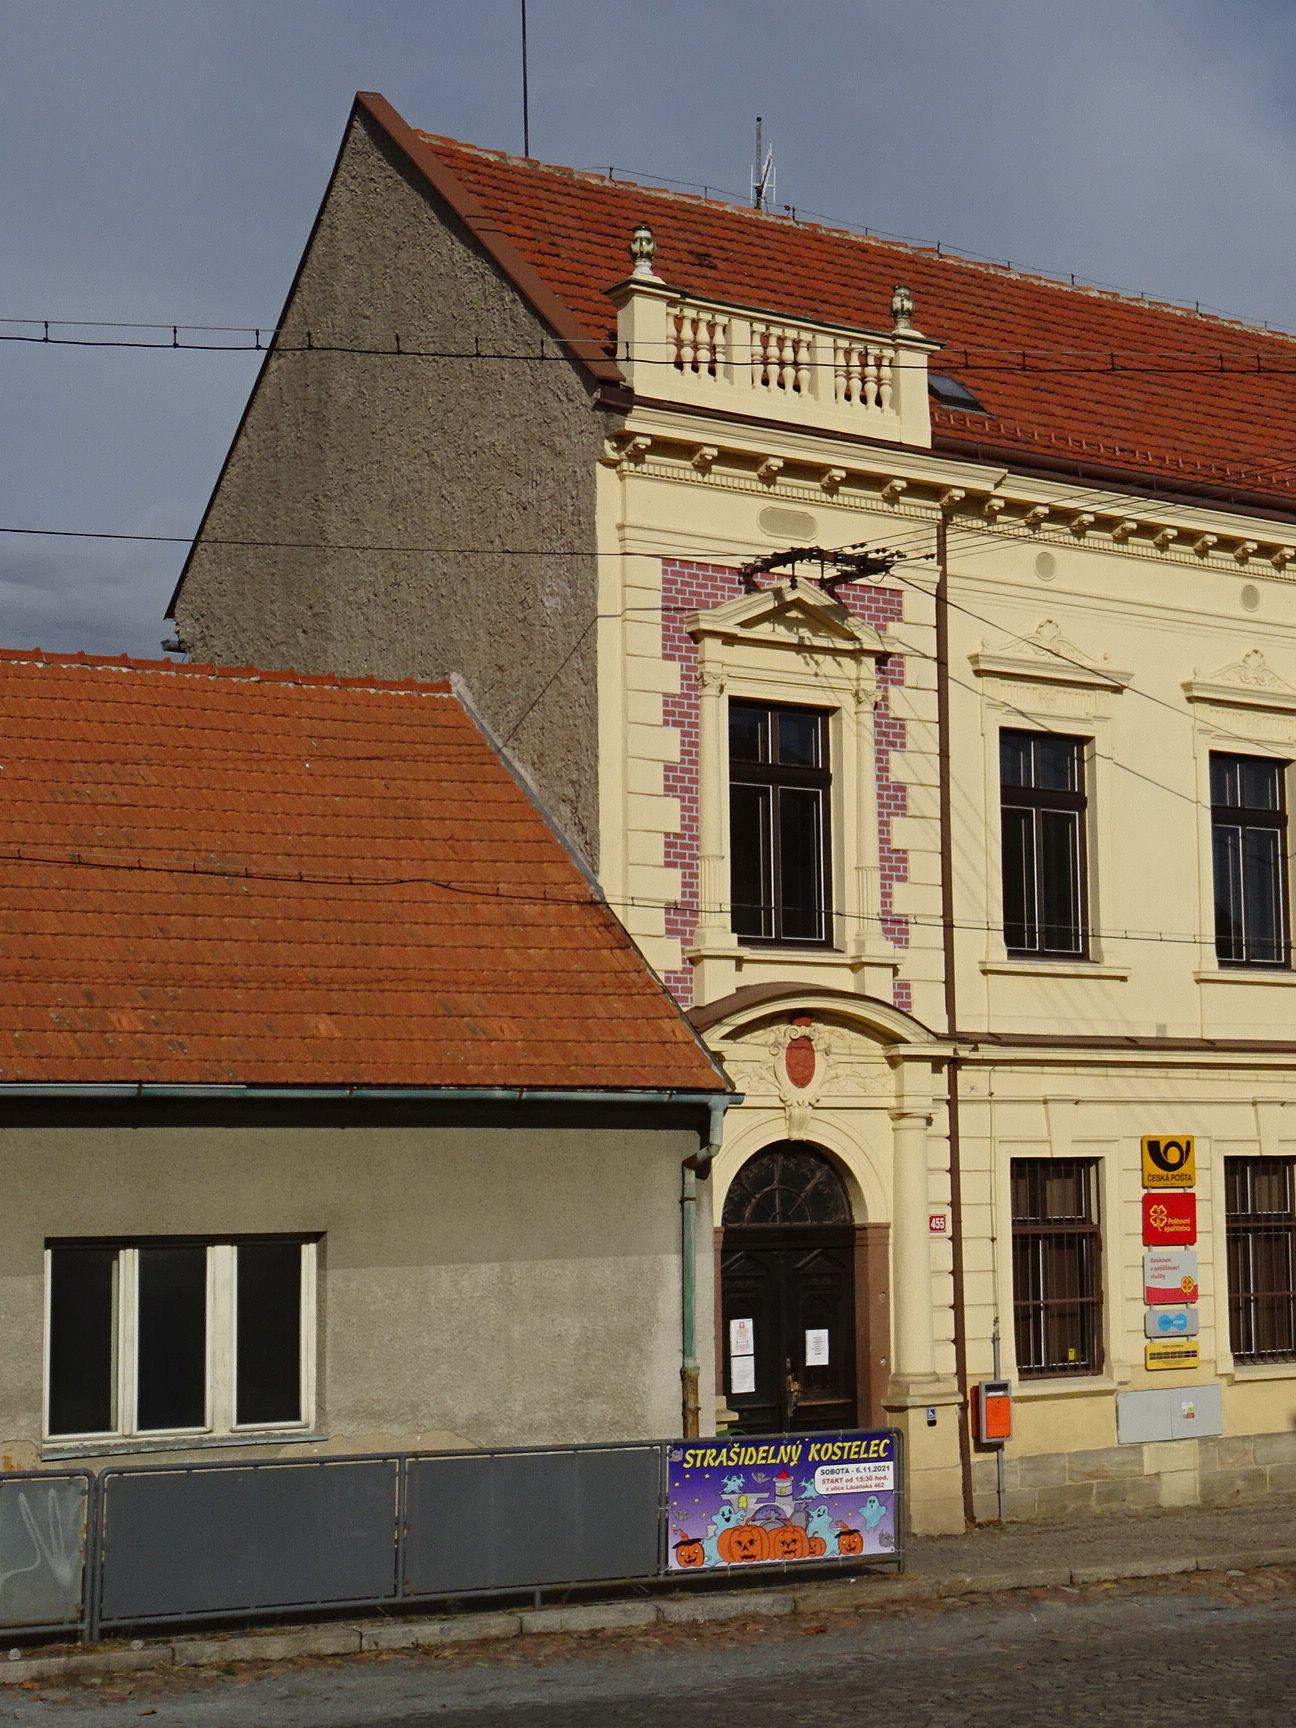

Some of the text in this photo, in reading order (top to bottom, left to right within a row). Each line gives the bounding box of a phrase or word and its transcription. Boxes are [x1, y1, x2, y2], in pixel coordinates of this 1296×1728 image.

[1147, 1172, 1192, 1182] ČESKÁ POŠTA
[931, 1217, 945, 1229] 455
[683, 1439, 890, 1468] STRAŠIDELNÝ KOSTELEC
[820, 1468, 850, 1476] SOBOTA
[856, 1465, 890, 1473] 6.11.2021
